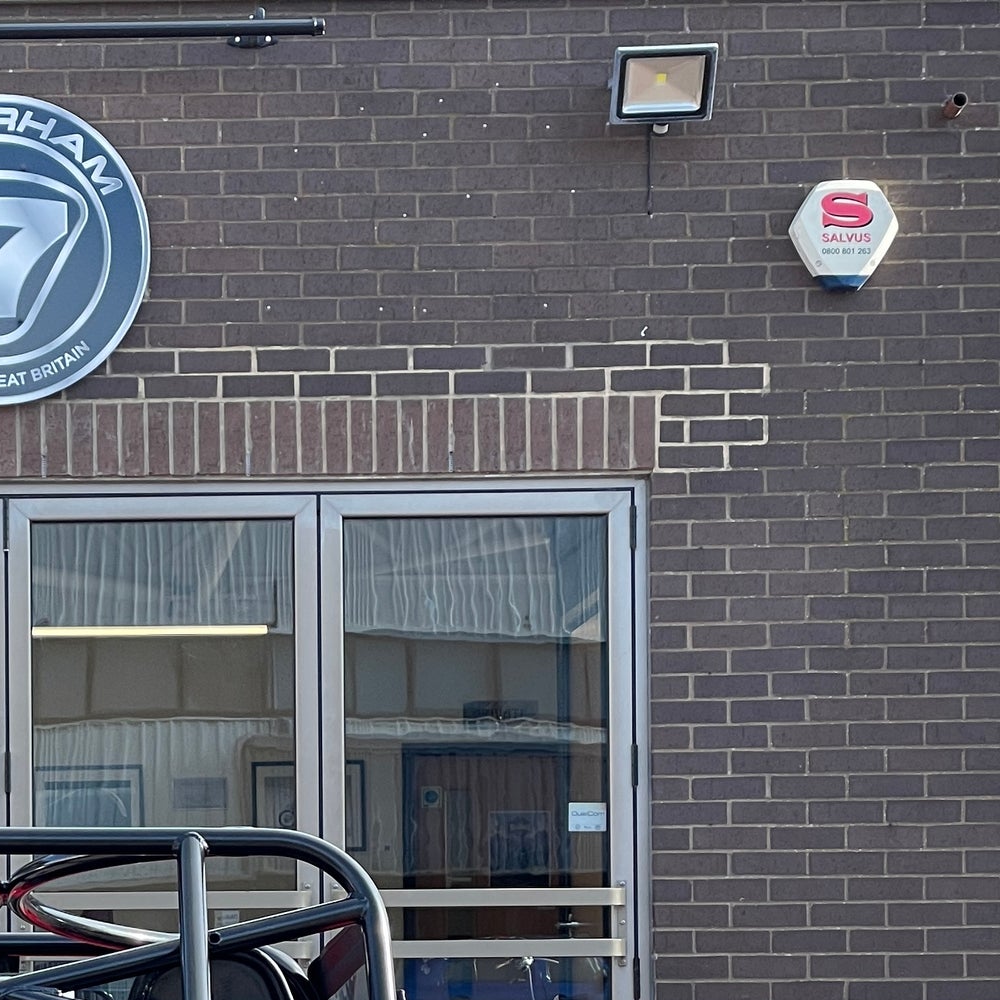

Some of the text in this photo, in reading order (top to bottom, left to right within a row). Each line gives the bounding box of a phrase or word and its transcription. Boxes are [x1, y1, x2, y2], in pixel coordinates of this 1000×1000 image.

[821, 191, 874, 229] S
[822, 233, 872, 243] SALVUS
[821, 247, 872, 255] 0800 801 263
[31, 340, 91, 382] BRITAIN
